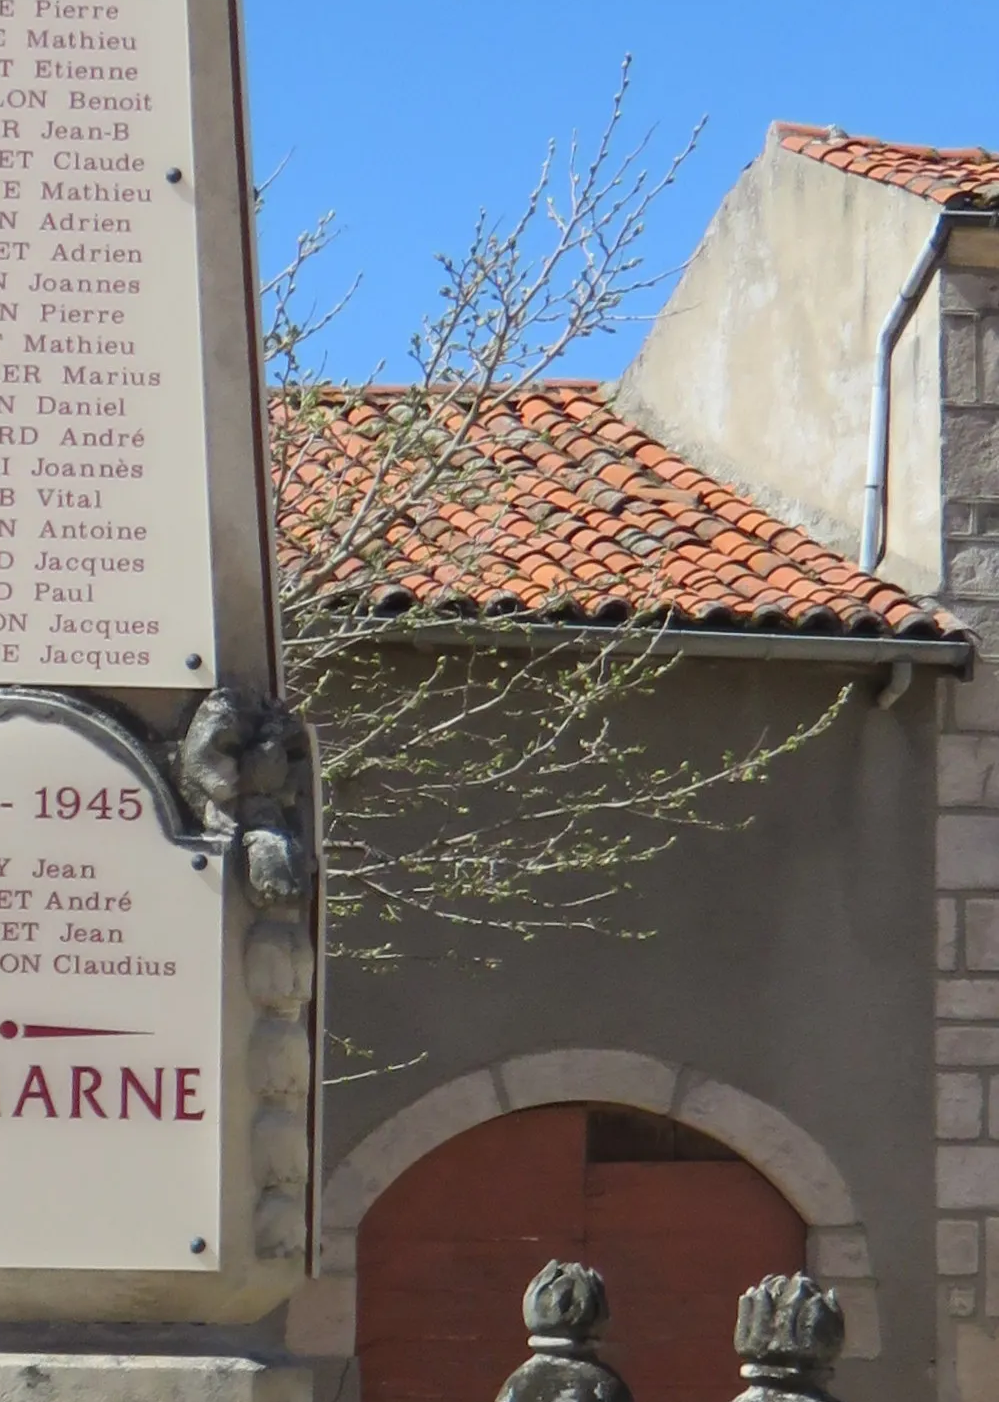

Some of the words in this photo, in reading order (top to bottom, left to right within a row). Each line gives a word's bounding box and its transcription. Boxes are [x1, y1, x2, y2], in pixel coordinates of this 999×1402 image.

[36, 0, 118, 20] Pierre
[27, 30, 136, 50] Mathieu
[35, 60, 138, 80] Etienne
[69, 91, 152, 111] Benoit
[41, 122, 130, 141] Jean-B
[54, 152, 145, 172] Claude
[41, 181, 151, 202] Mathieu
[40, 212, 132, 233] Adrien
[52, 243, 142, 263] Adrien
[28, 273, 140, 294] Joannes
[40, 304, 125, 324] Pierre
[24, 334, 134, 355] Mathieu
[63, 366, 161, 386] Marius
[38, 396, 126, 417] Daniel
[60, 427, 144, 448] André
[31, 458, 143, 479] Joannès
[37, 488, 102, 509] Vital
[39, 520, 147, 541] Antoine
[34, 552, 145, 577] Jacques
[34, 583, 94, 603] Paul
[49, 615, 159, 638] Jacques
[39, 645, 150, 670] Jacques
[34, 787, 142, 821] 1945
[32, 859, 96, 879] Jean
[44, 891, 132, 911] André
[59, 923, 124, 943] Jean
[53, 955, 176, 977] Claudius
